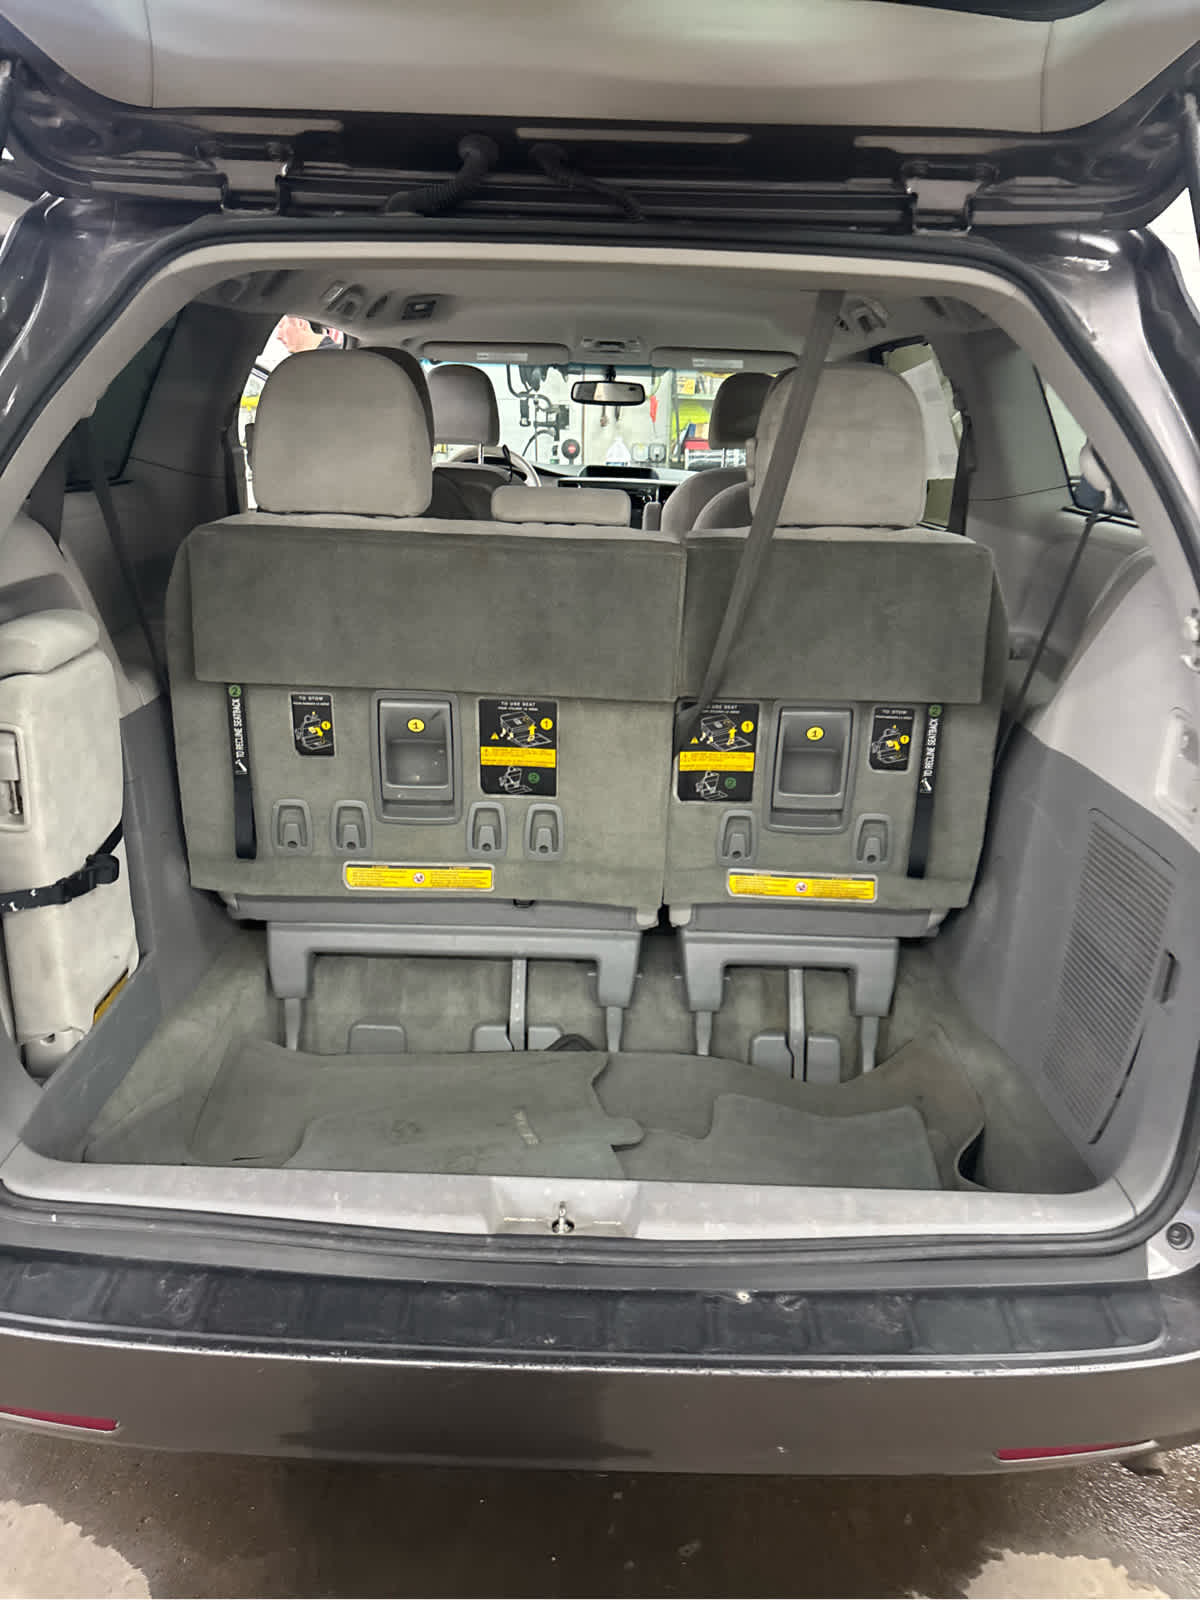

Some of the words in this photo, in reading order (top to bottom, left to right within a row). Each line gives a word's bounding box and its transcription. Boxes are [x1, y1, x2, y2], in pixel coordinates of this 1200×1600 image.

[231, 698, 242, 728] SEATBACK
[234, 728, 244, 751] RECLINE
[927, 718, 939, 746] SEATBACK
[924, 747, 936, 770] RECLINE
